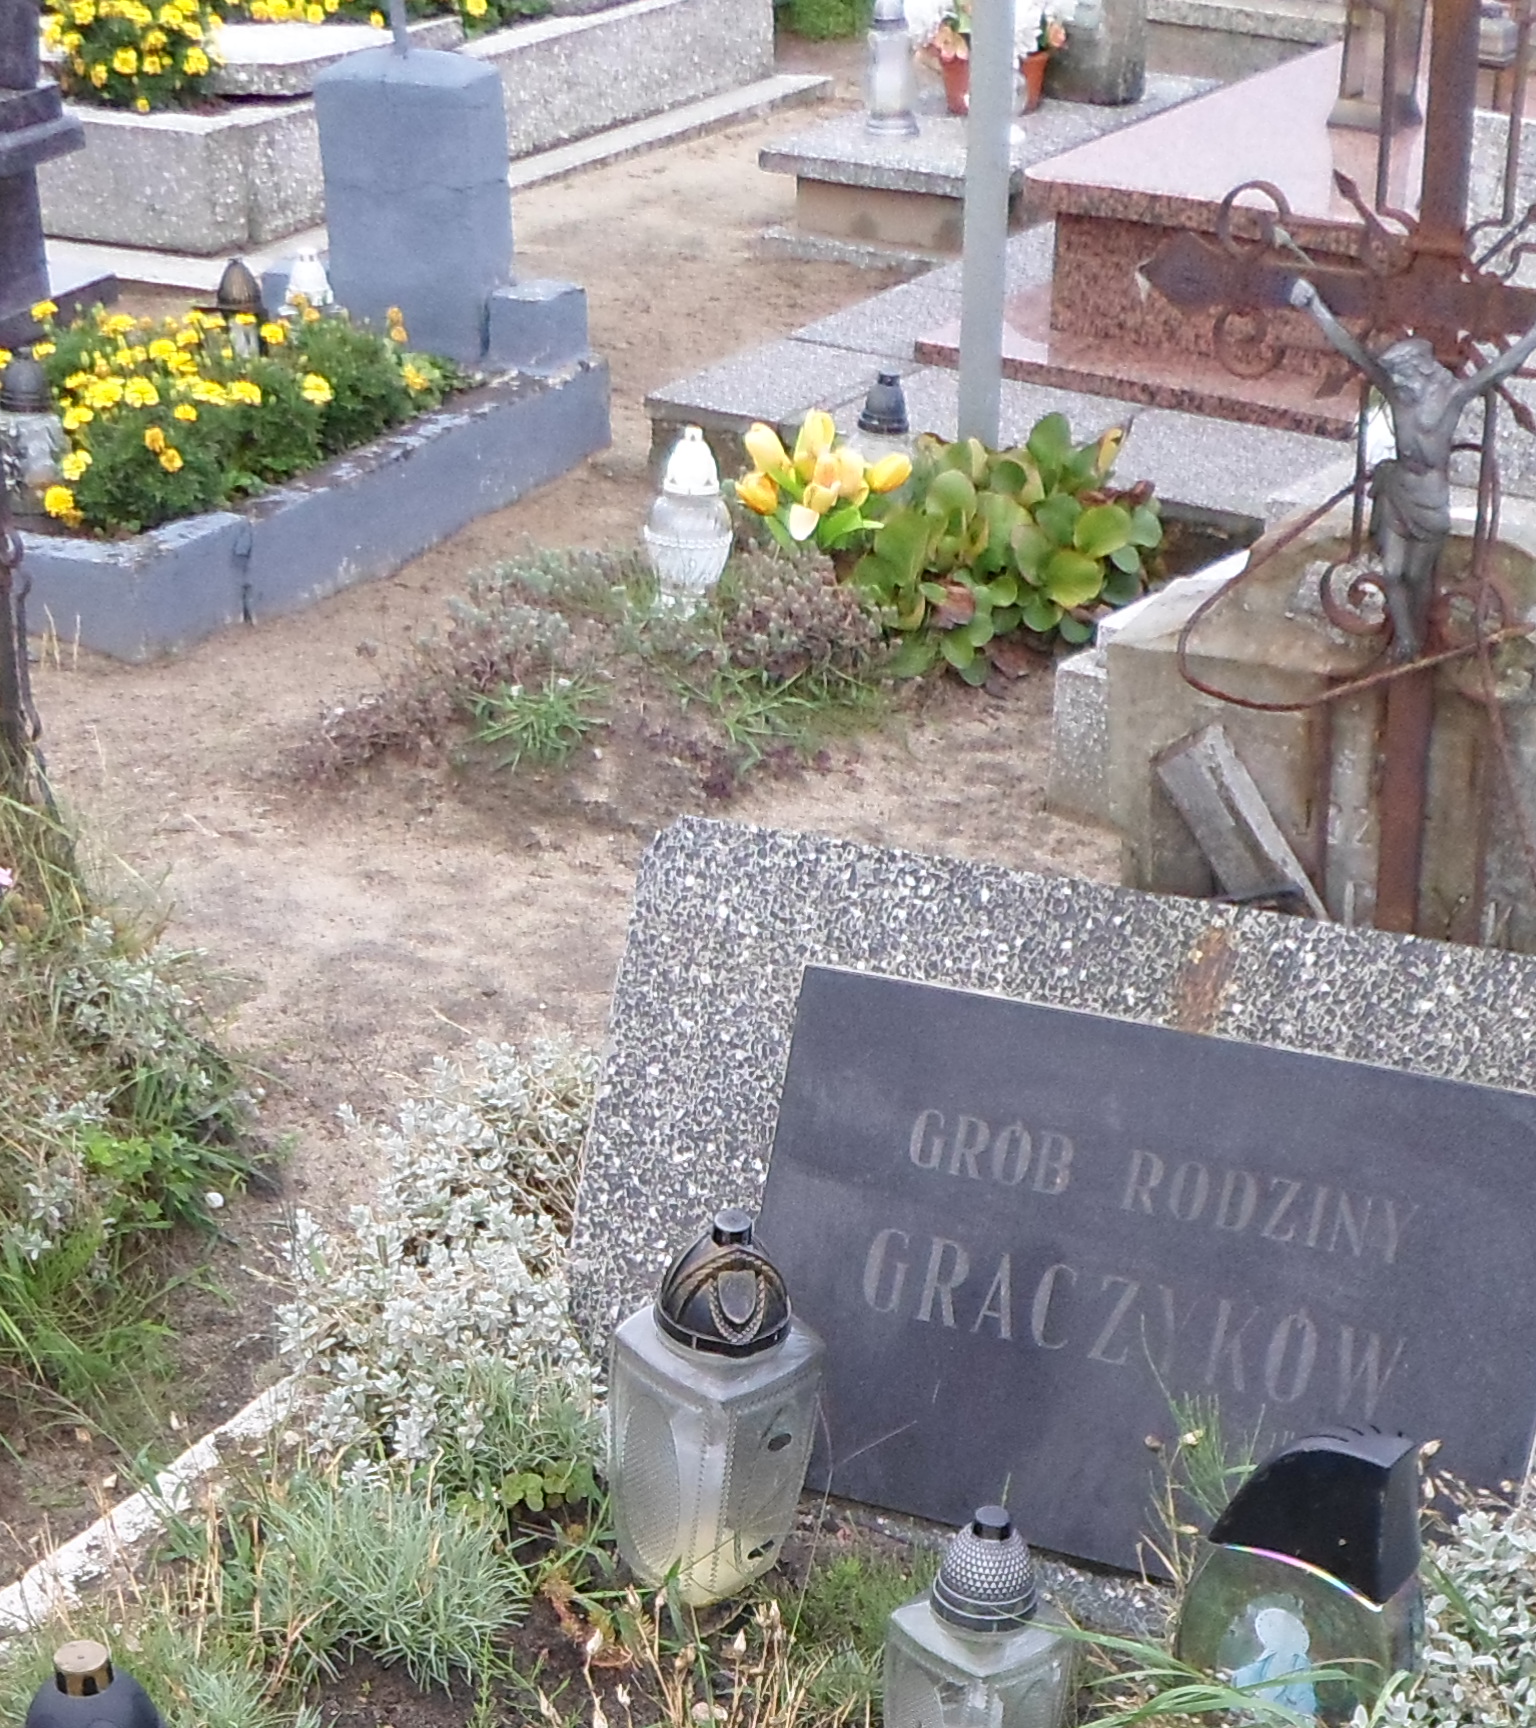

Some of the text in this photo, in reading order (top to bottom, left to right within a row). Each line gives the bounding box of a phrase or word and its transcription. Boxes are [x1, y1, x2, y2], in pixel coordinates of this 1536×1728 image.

[908, 1107, 1420, 1265] GRÓB RODZINY
[862, 1227, 1408, 1420] GRACZYKÓW
